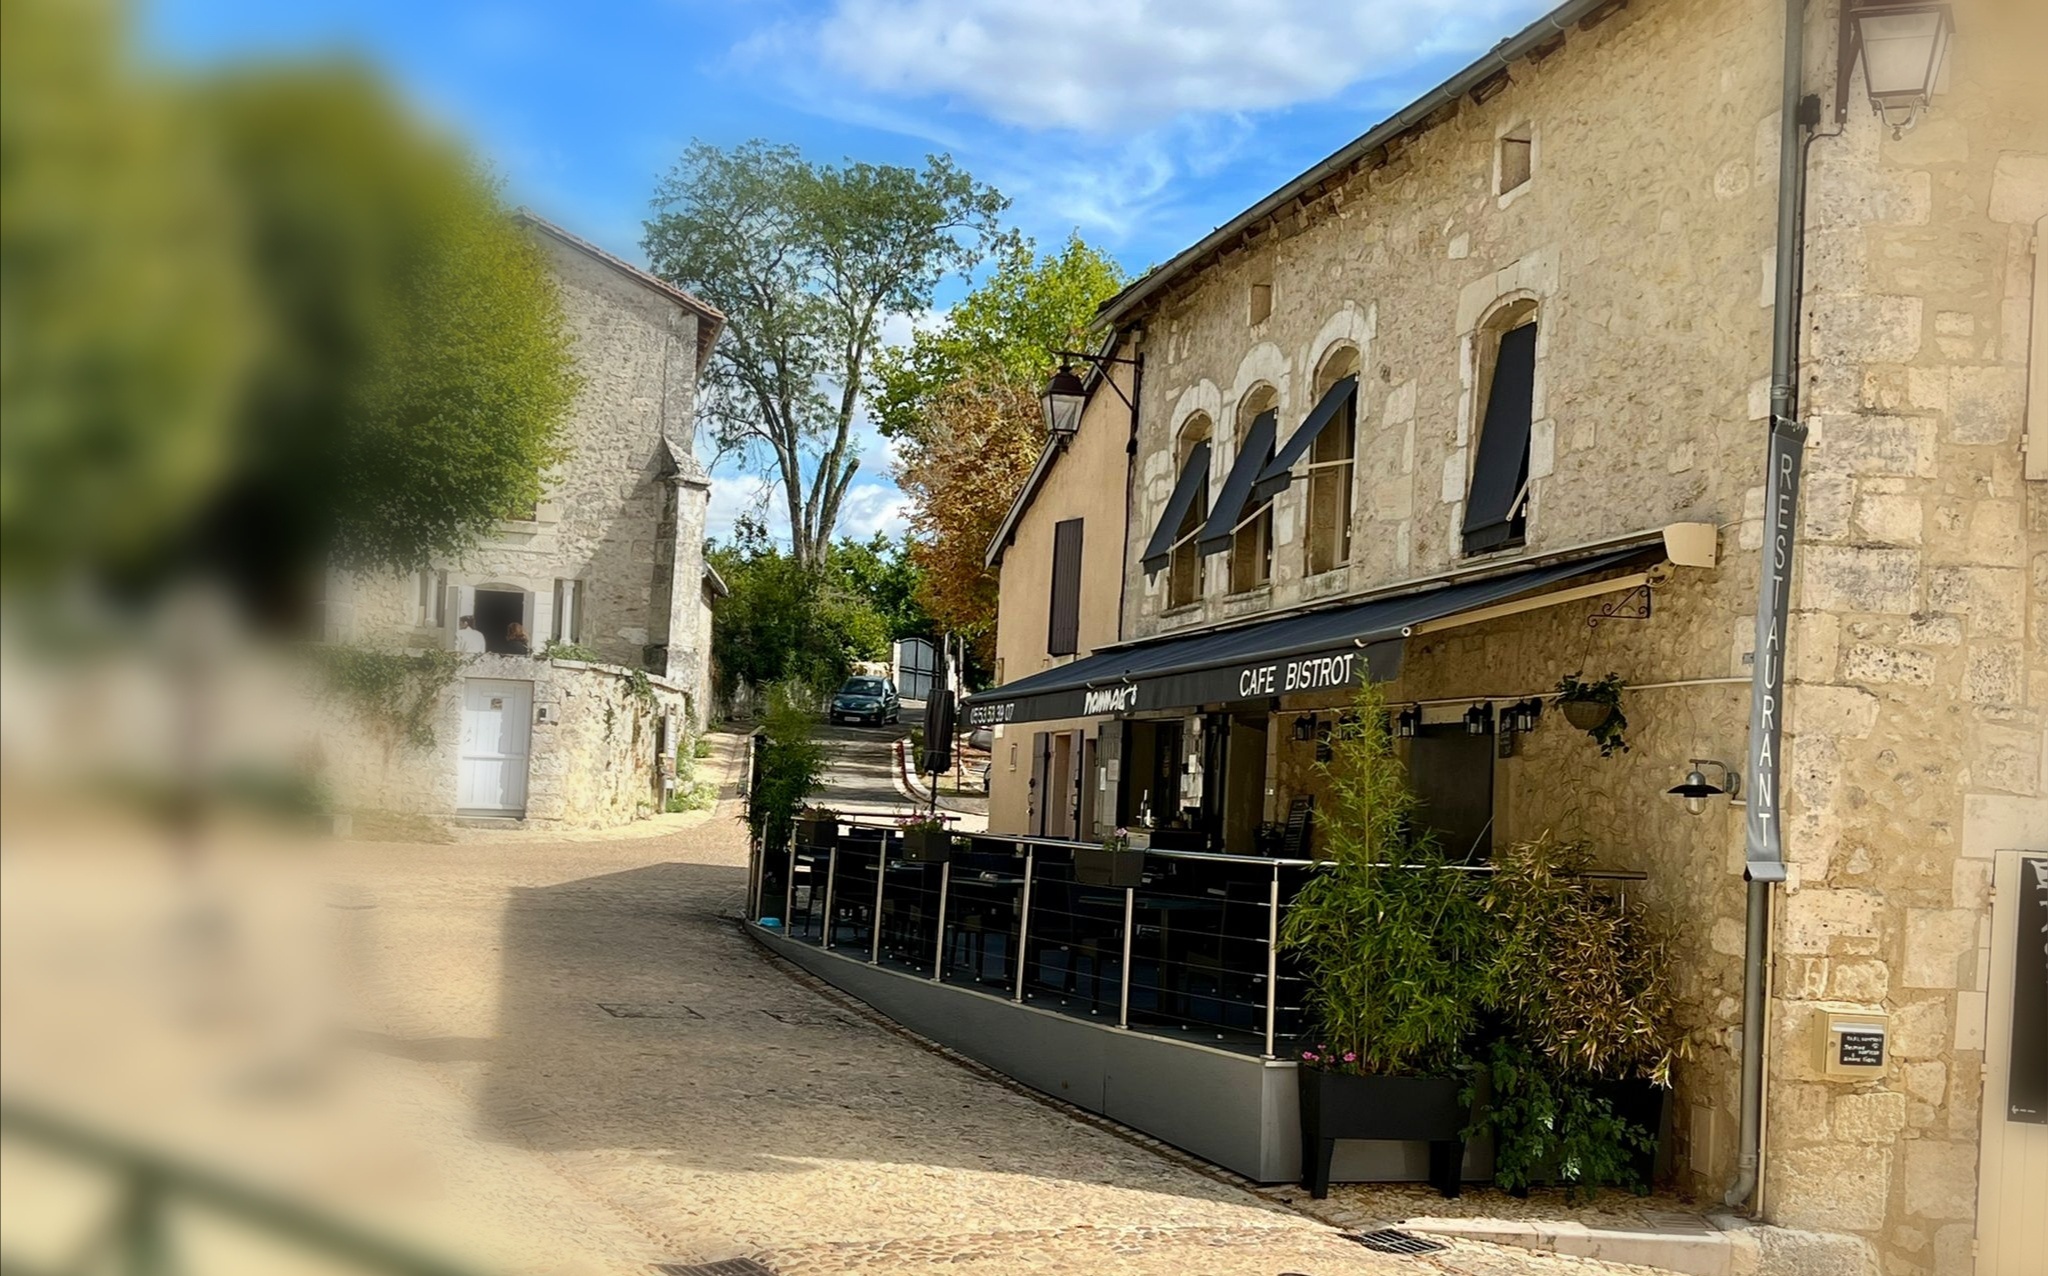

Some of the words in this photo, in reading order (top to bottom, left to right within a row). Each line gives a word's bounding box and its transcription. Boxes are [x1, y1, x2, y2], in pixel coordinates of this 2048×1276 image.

[1239, 665, 1277, 697] CAFE
[1284, 653, 1354, 691] BISTROT
[1758, 453, 1793, 846] RESTAURANT
